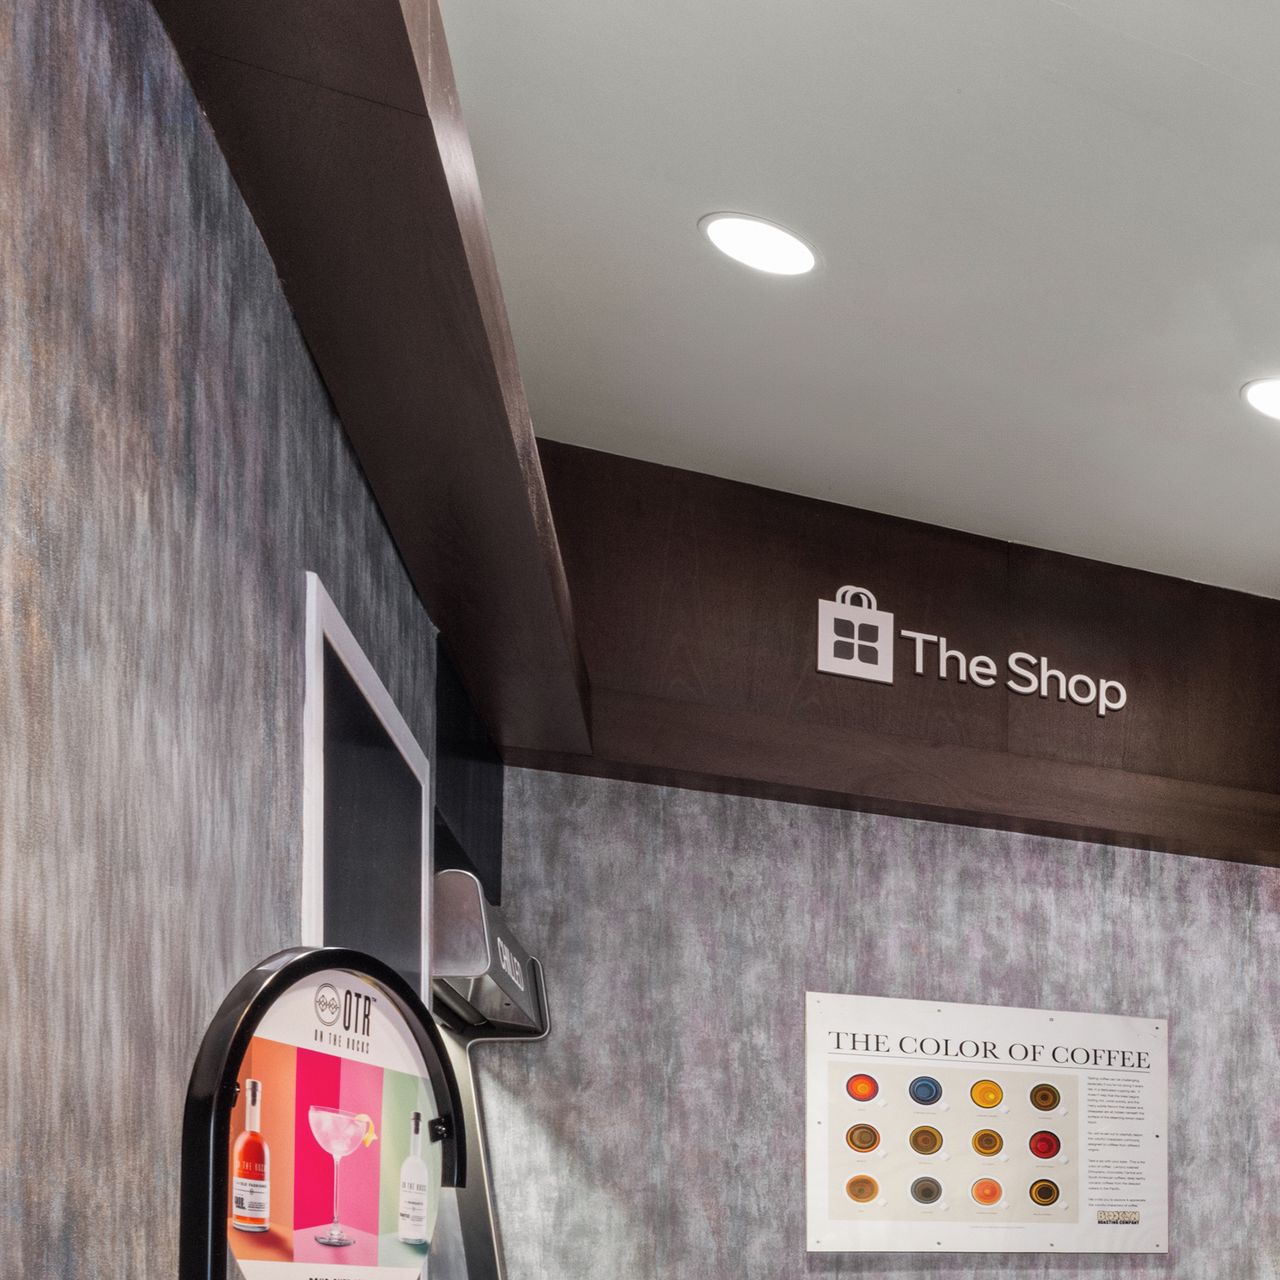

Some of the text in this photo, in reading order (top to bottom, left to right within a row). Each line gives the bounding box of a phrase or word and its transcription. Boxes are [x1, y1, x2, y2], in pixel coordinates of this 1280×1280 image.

[900, 629, 1127, 716] The Shop
[343, 989, 371, 1037] OTR
[314, 1029, 370, 1054] ON THE ROCKS
[828, 1031, 1151, 1069] THE COLOR OF COFFEE
